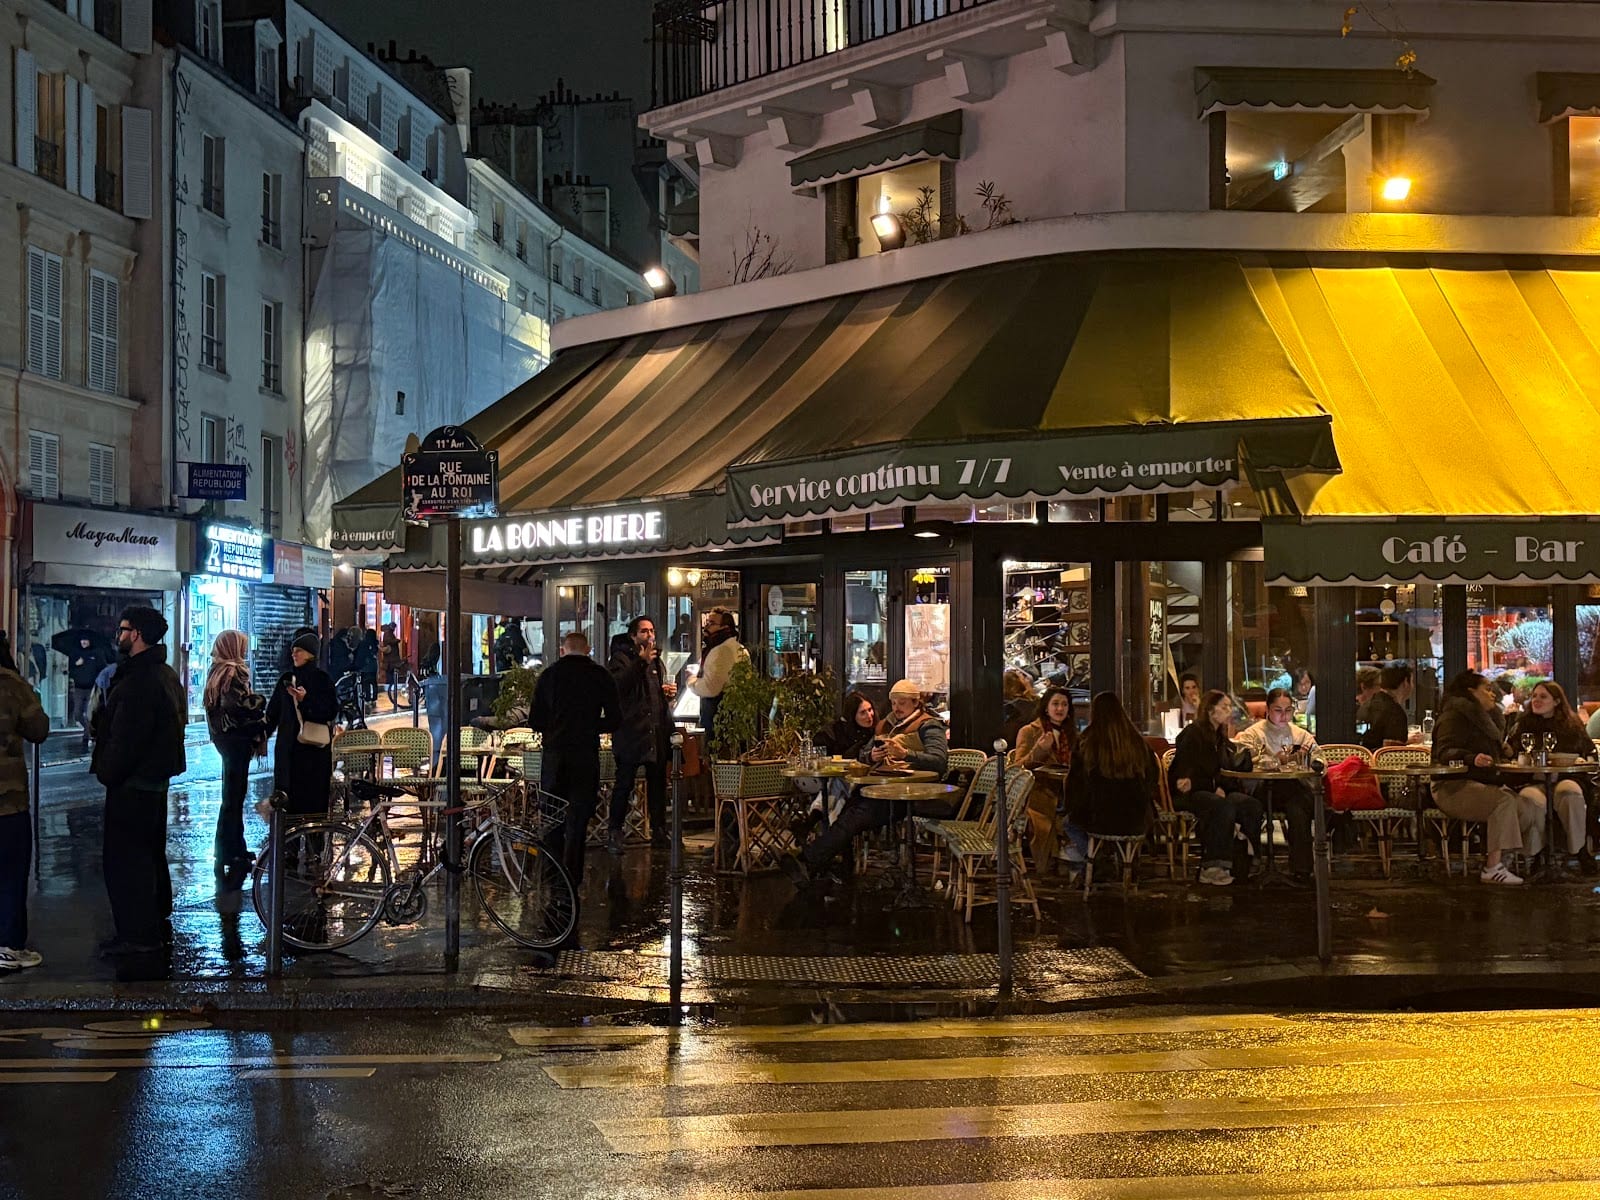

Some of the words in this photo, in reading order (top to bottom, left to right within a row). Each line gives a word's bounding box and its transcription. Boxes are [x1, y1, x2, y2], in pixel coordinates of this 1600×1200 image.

[440, 461, 462, 473] RUE
[1058, 463, 1117, 481] Vente
[1121, 461, 1134, 478] à
[1138, 457, 1236, 477] emporter
[193, 469, 242, 479] ALIMENTATION
[411, 474, 426, 486] DE
[427, 474, 441, 486] LA
[442, 473, 490, 486] FONTAINE
[193, 479, 242, 489] REPUBLIQUE
[750, 477, 832, 508] Service
[836, 463, 940, 498] continu
[956, 458, 1012, 488] 7/7
[430, 487, 447, 498] AU
[452, 486, 472, 498] ROI
[349, 529, 396, 542] emporter
[473, 525, 502, 553] LA
[506, 518, 584, 550] BONNE
[587, 511, 662, 544] BIERE
[1381, 534, 1467, 564] Café
[1515, 536, 1585, 563] Bar
